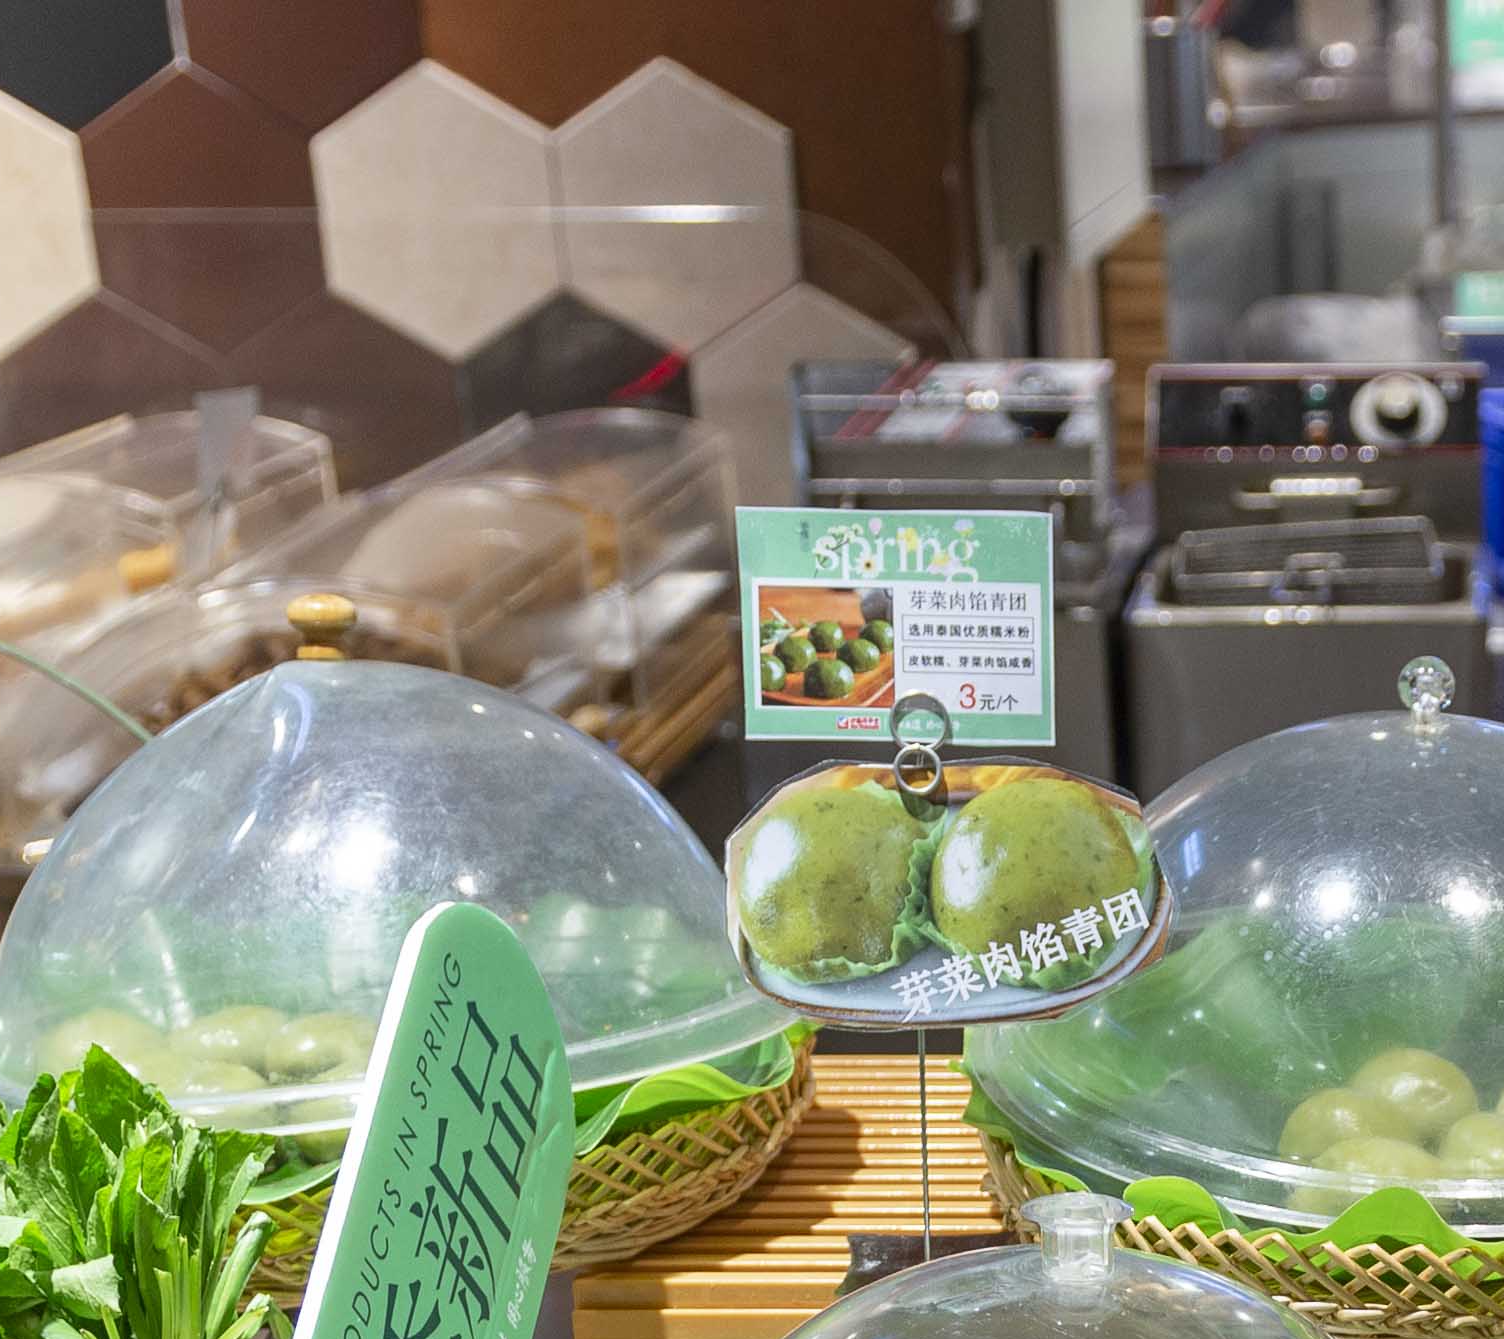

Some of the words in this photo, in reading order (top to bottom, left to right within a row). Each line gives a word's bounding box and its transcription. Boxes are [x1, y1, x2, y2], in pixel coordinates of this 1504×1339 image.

[812, 522, 981, 584] spring
[909, 589, 1027, 612] 芽菜肉馅青团
[908, 623, 1030, 639] 选用泰国优质糯米粉
[908, 655, 1033, 670] 皮软糯、芽菜肉馅咸香
[890, 886, 1151, 1024] 芽菜肉馅青团
[395, 1124, 419, 1171] IN
[411, 951, 464, 1110] SPRING
